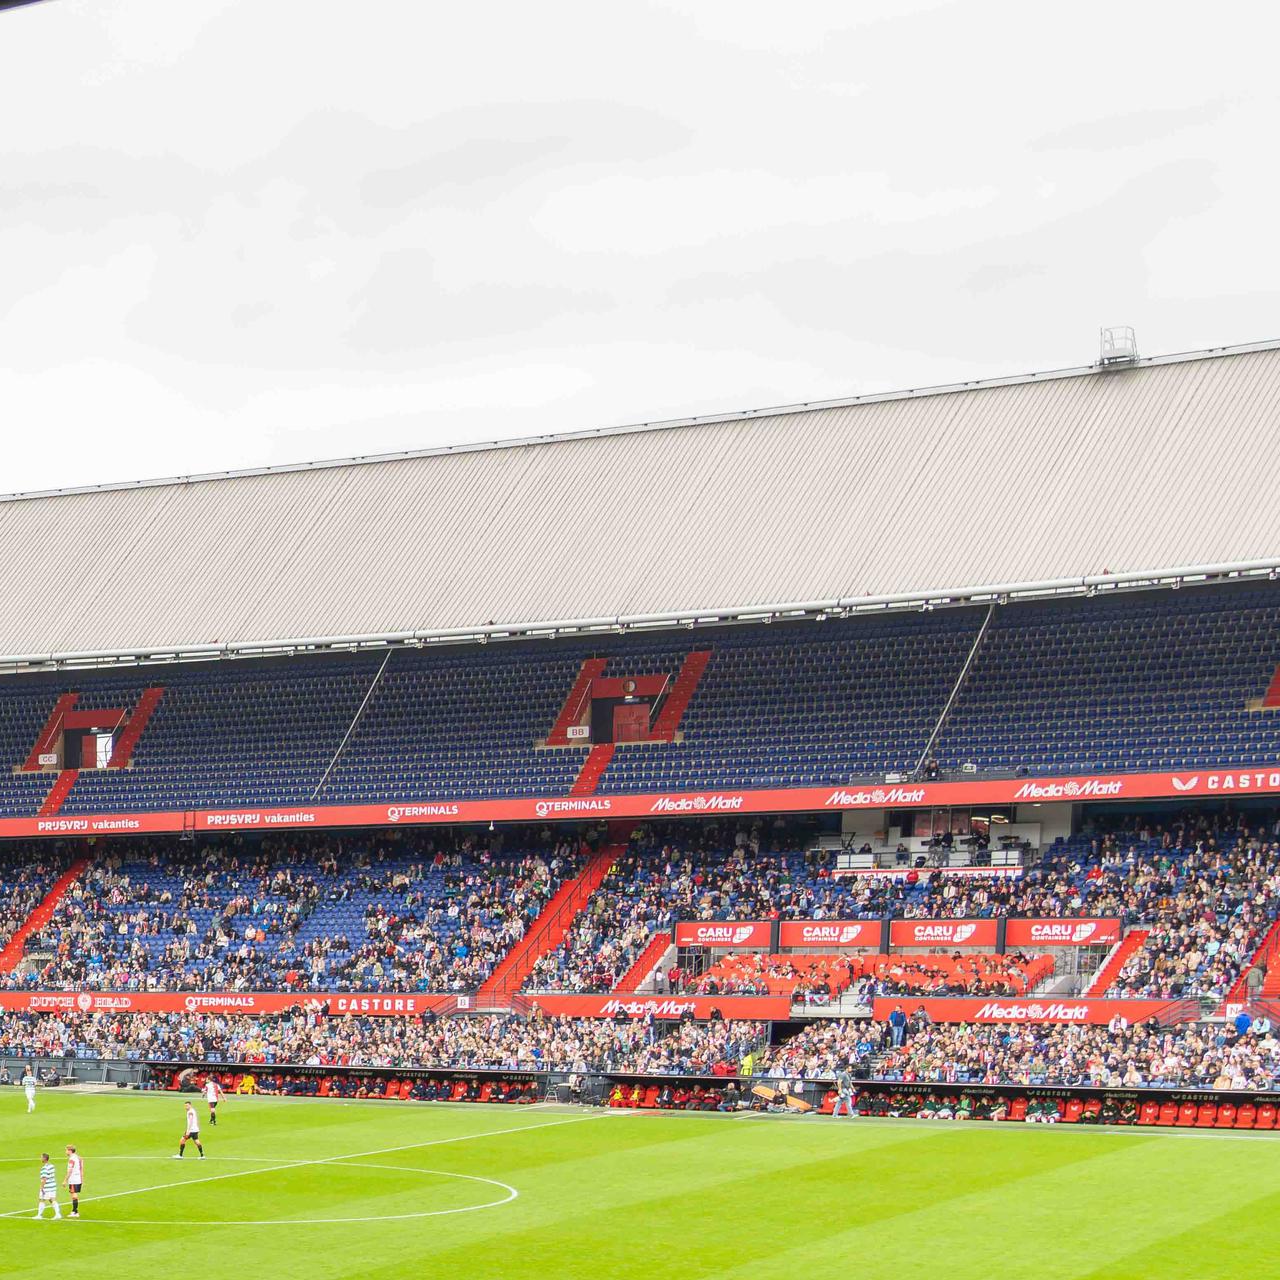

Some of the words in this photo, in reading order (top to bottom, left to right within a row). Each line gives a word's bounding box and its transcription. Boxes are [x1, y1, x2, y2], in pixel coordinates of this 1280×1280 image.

[1208, 774, 1280, 788] CASTO
[1014, 780, 1122, 798] MediaMarkt
[826, 788, 925, 804] MediaMarkt
[651, 796, 743, 811] MediaMarkt
[265, 812, 314, 822] vakanties
[92, 819, 139, 828] vakanties
[698, 928, 732, 937] CARU
[803, 927, 838, 937] CARU
[915, 926, 952, 936] CARU
[1031, 925, 1071, 936] CARU
[30, 996, 74, 1008] DUTCH
[94, 997, 132, 1008] HEAD
[338, 999, 414, 1010] CASTORE
[975, 1004, 1088, 1019] MediaMarkt
